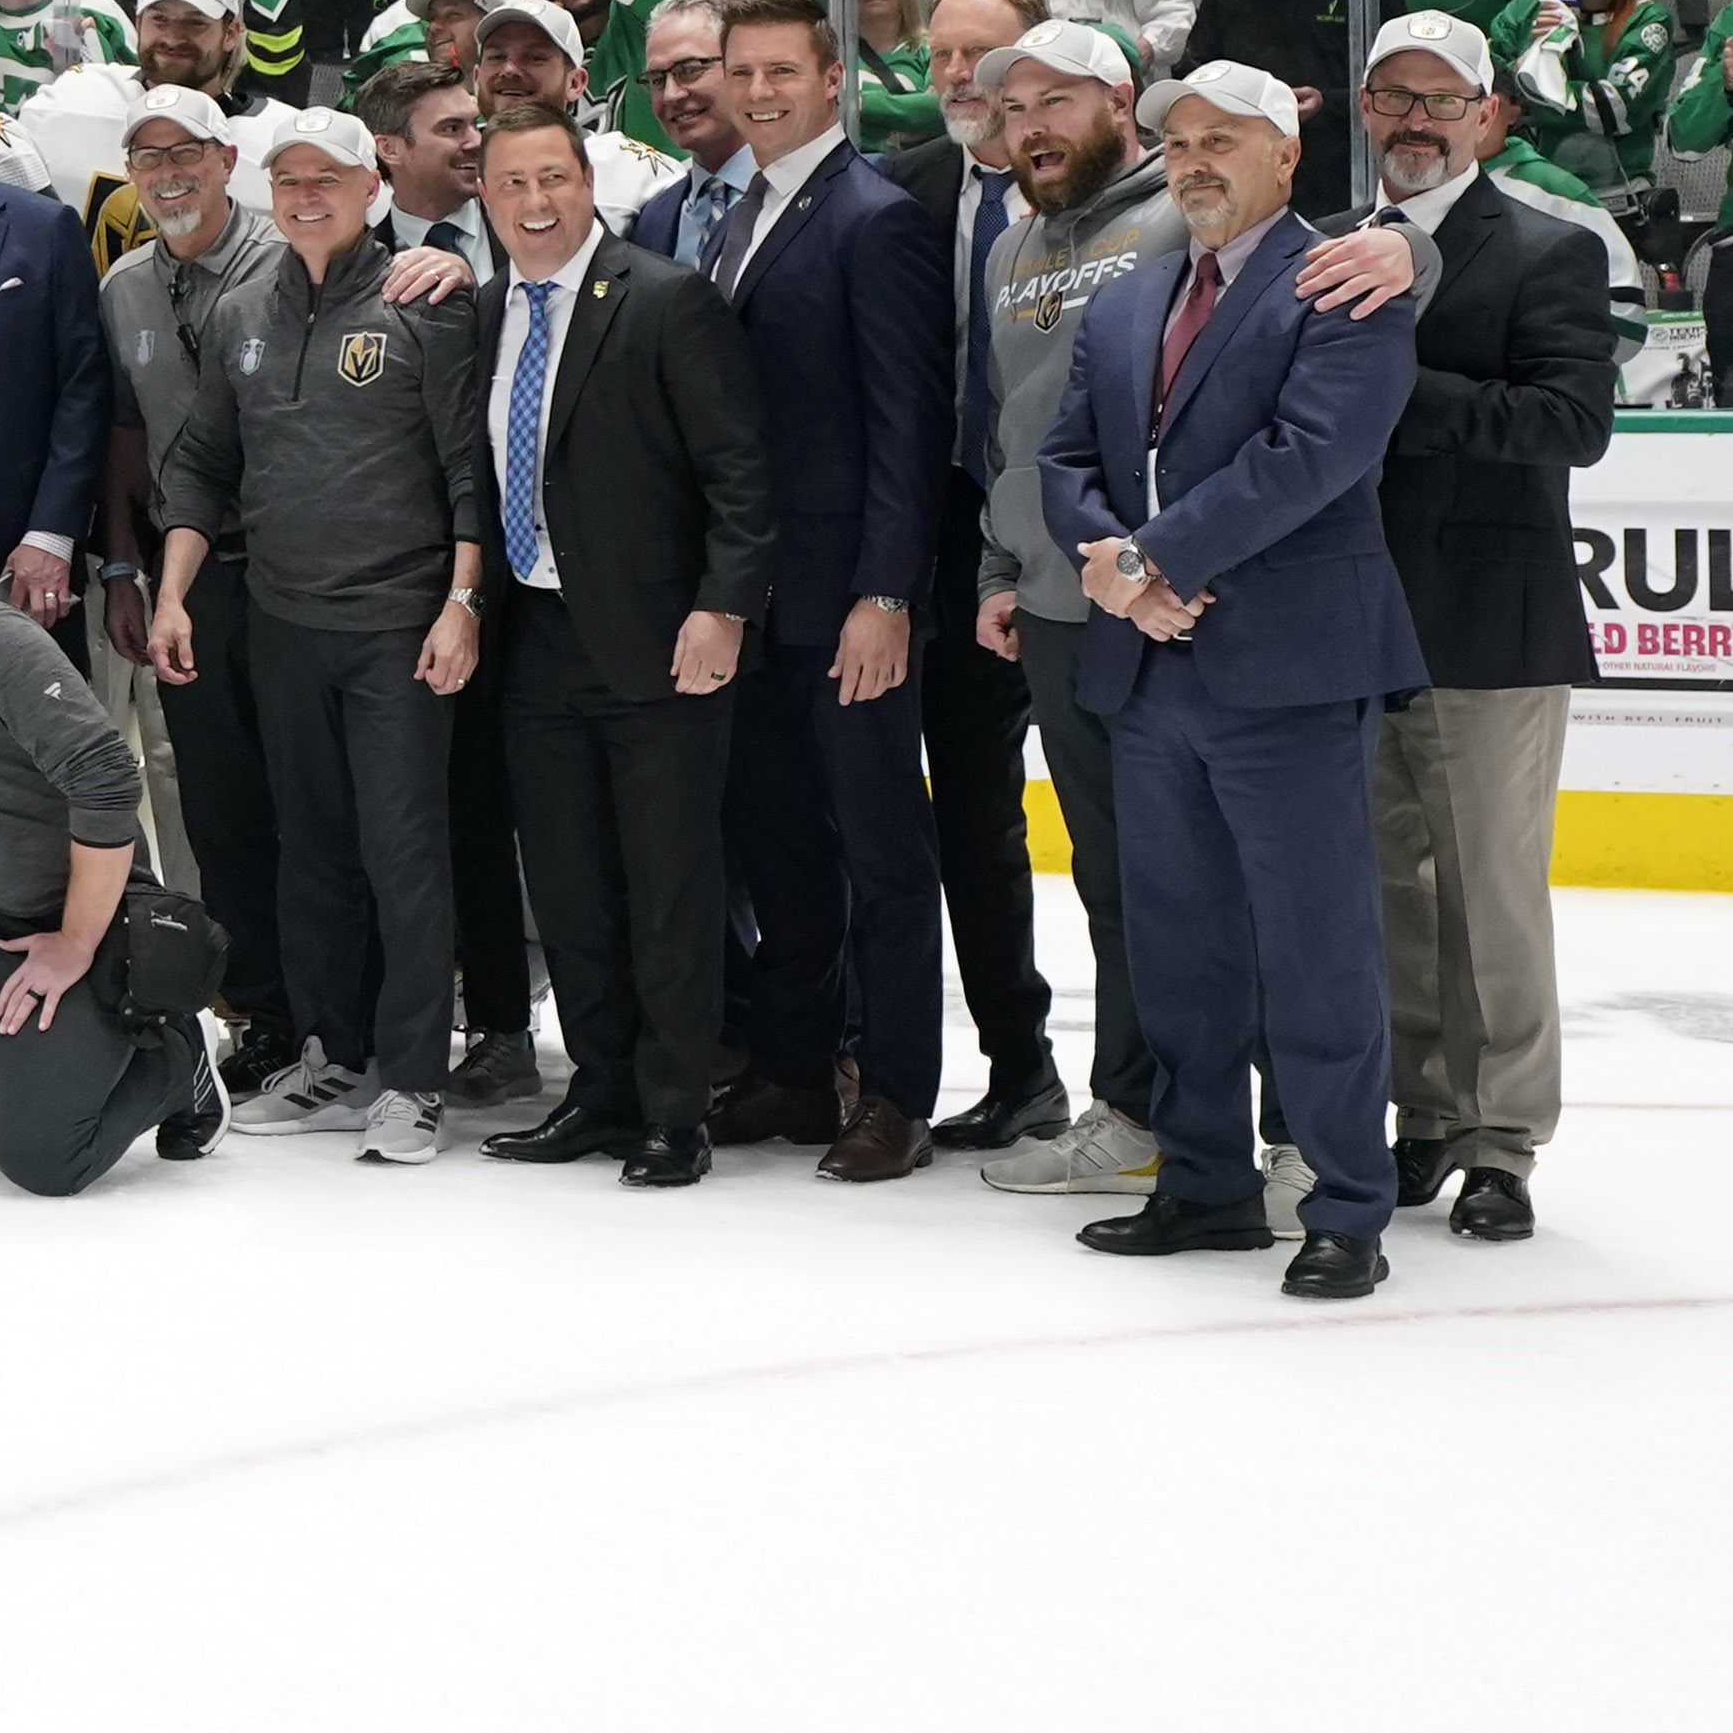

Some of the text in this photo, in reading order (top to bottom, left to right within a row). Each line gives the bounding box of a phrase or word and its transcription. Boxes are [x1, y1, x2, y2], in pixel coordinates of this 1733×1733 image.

[1089, 229, 1141, 257] CUP
[994, 251, 1138, 315] PLAYOFFS
[1603, 662, 1716, 673] OTHER NATURAL FLAVORS
